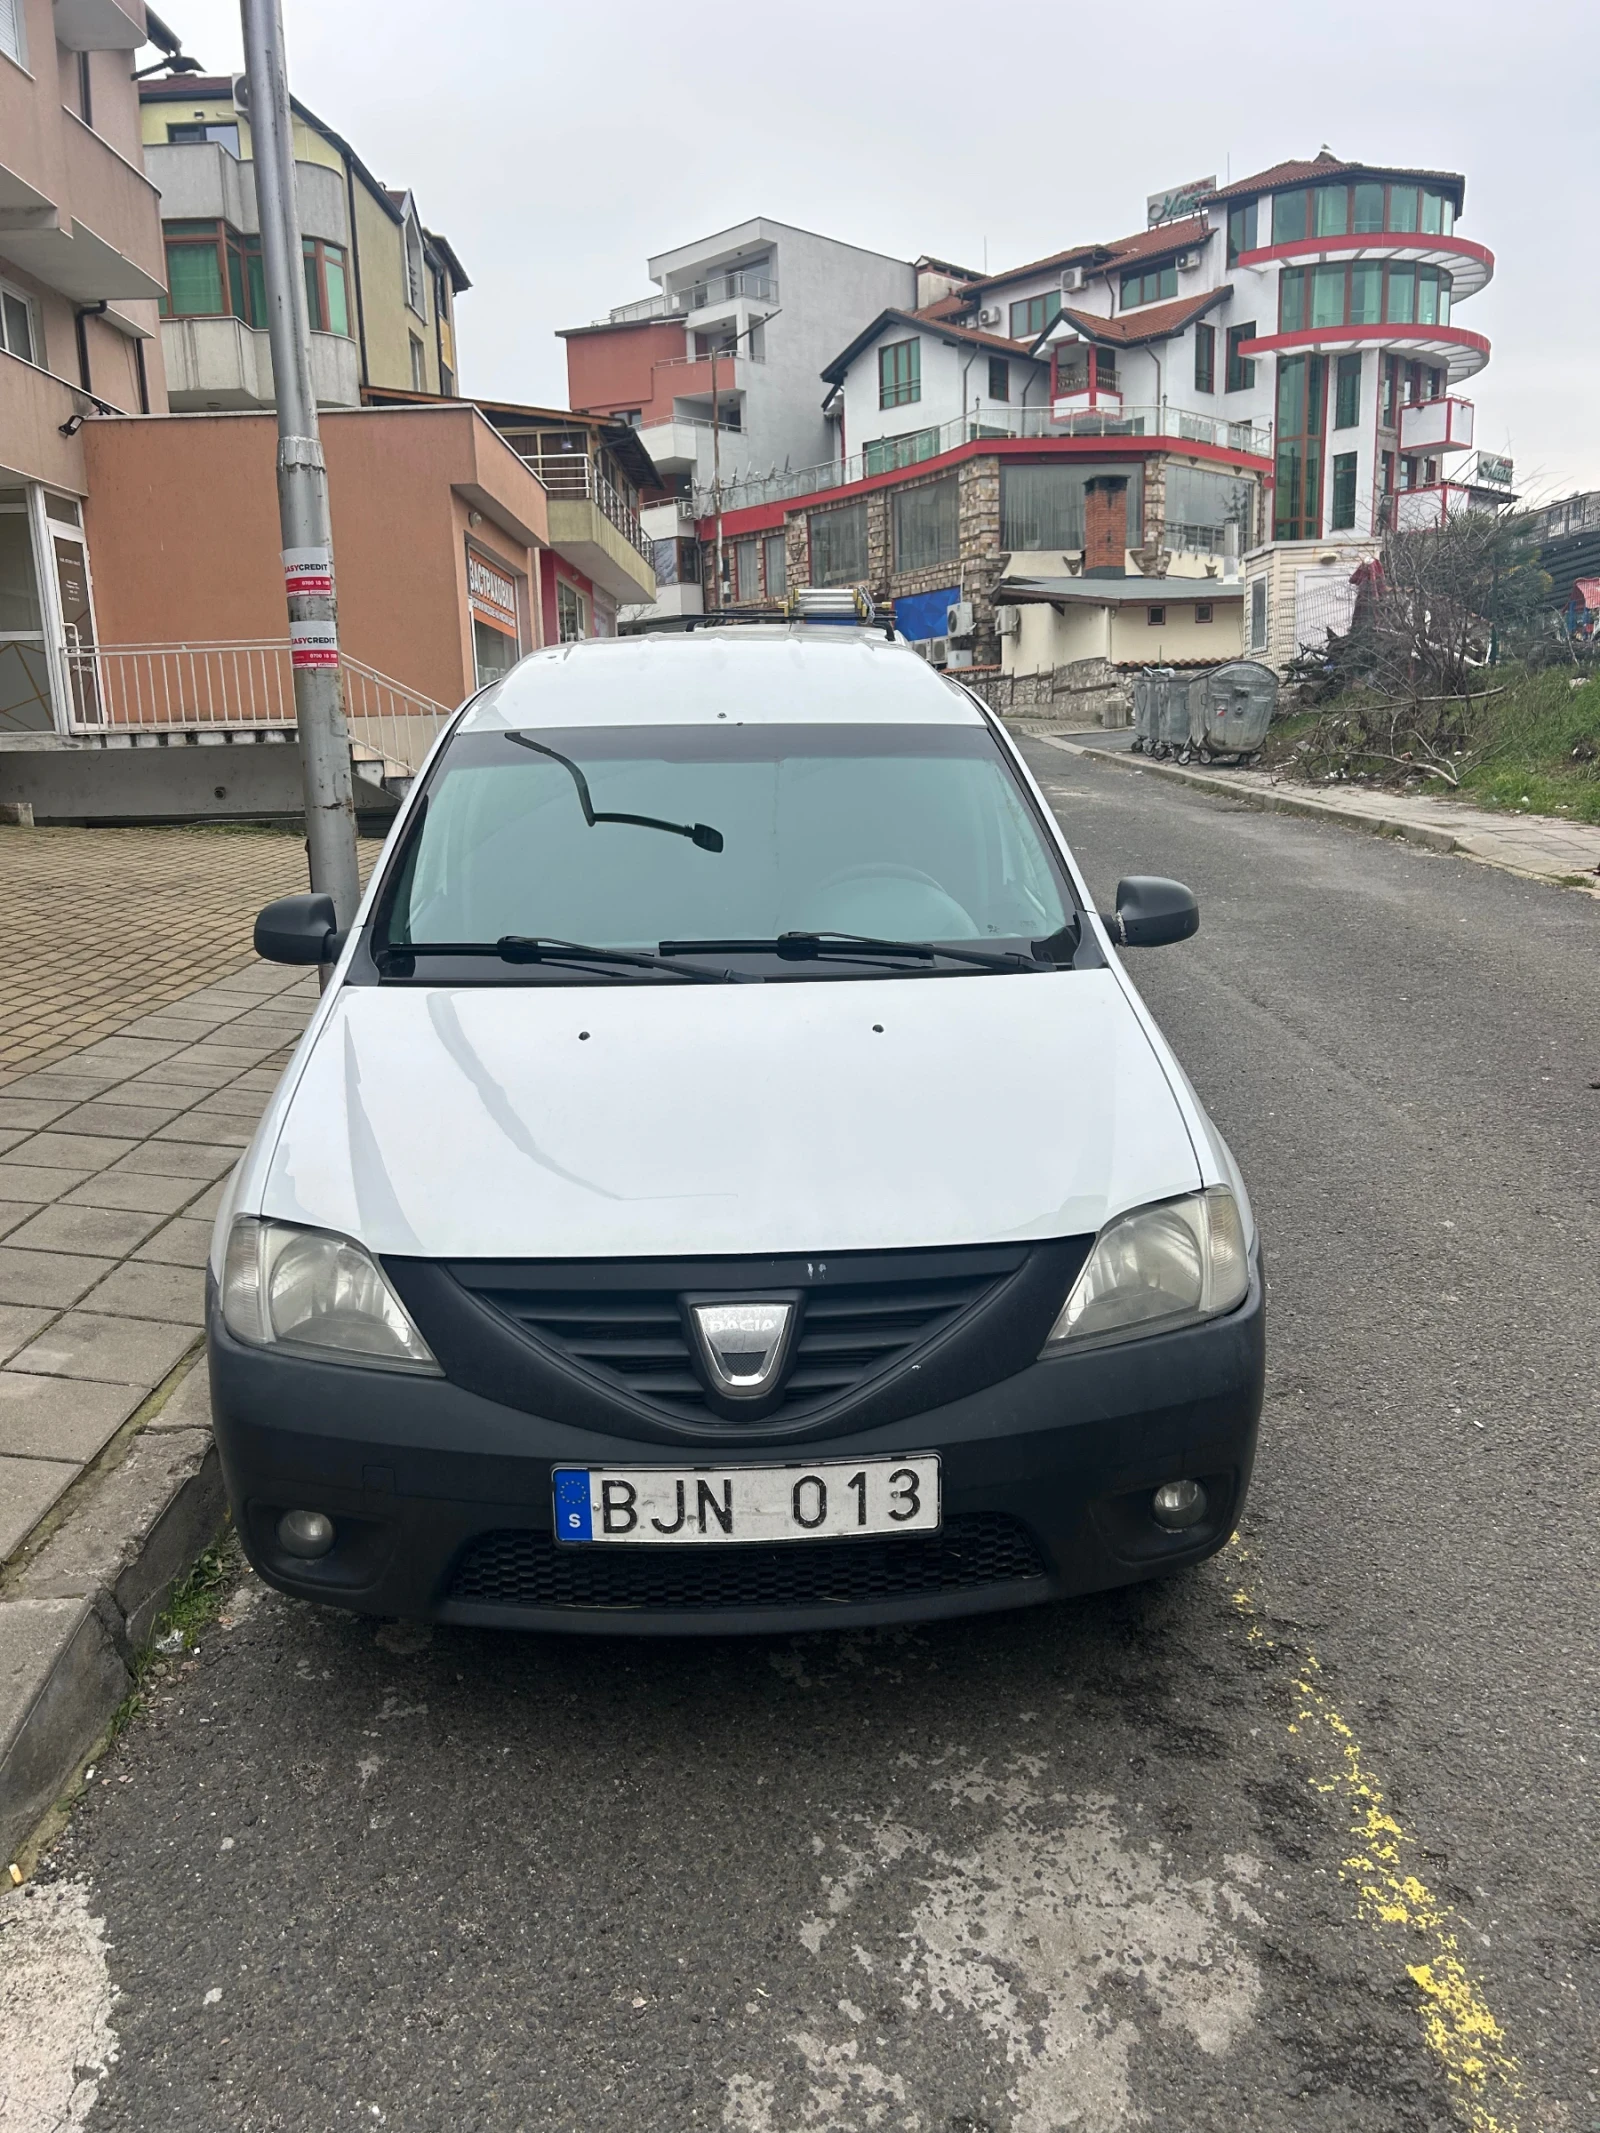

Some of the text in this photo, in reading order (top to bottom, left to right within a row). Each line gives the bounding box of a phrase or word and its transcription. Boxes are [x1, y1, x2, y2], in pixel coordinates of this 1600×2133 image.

[708, 1318, 775, 1334] DACIA
[602, 1468, 921, 1534] BJN 013
[569, 1513, 581, 1528] S
